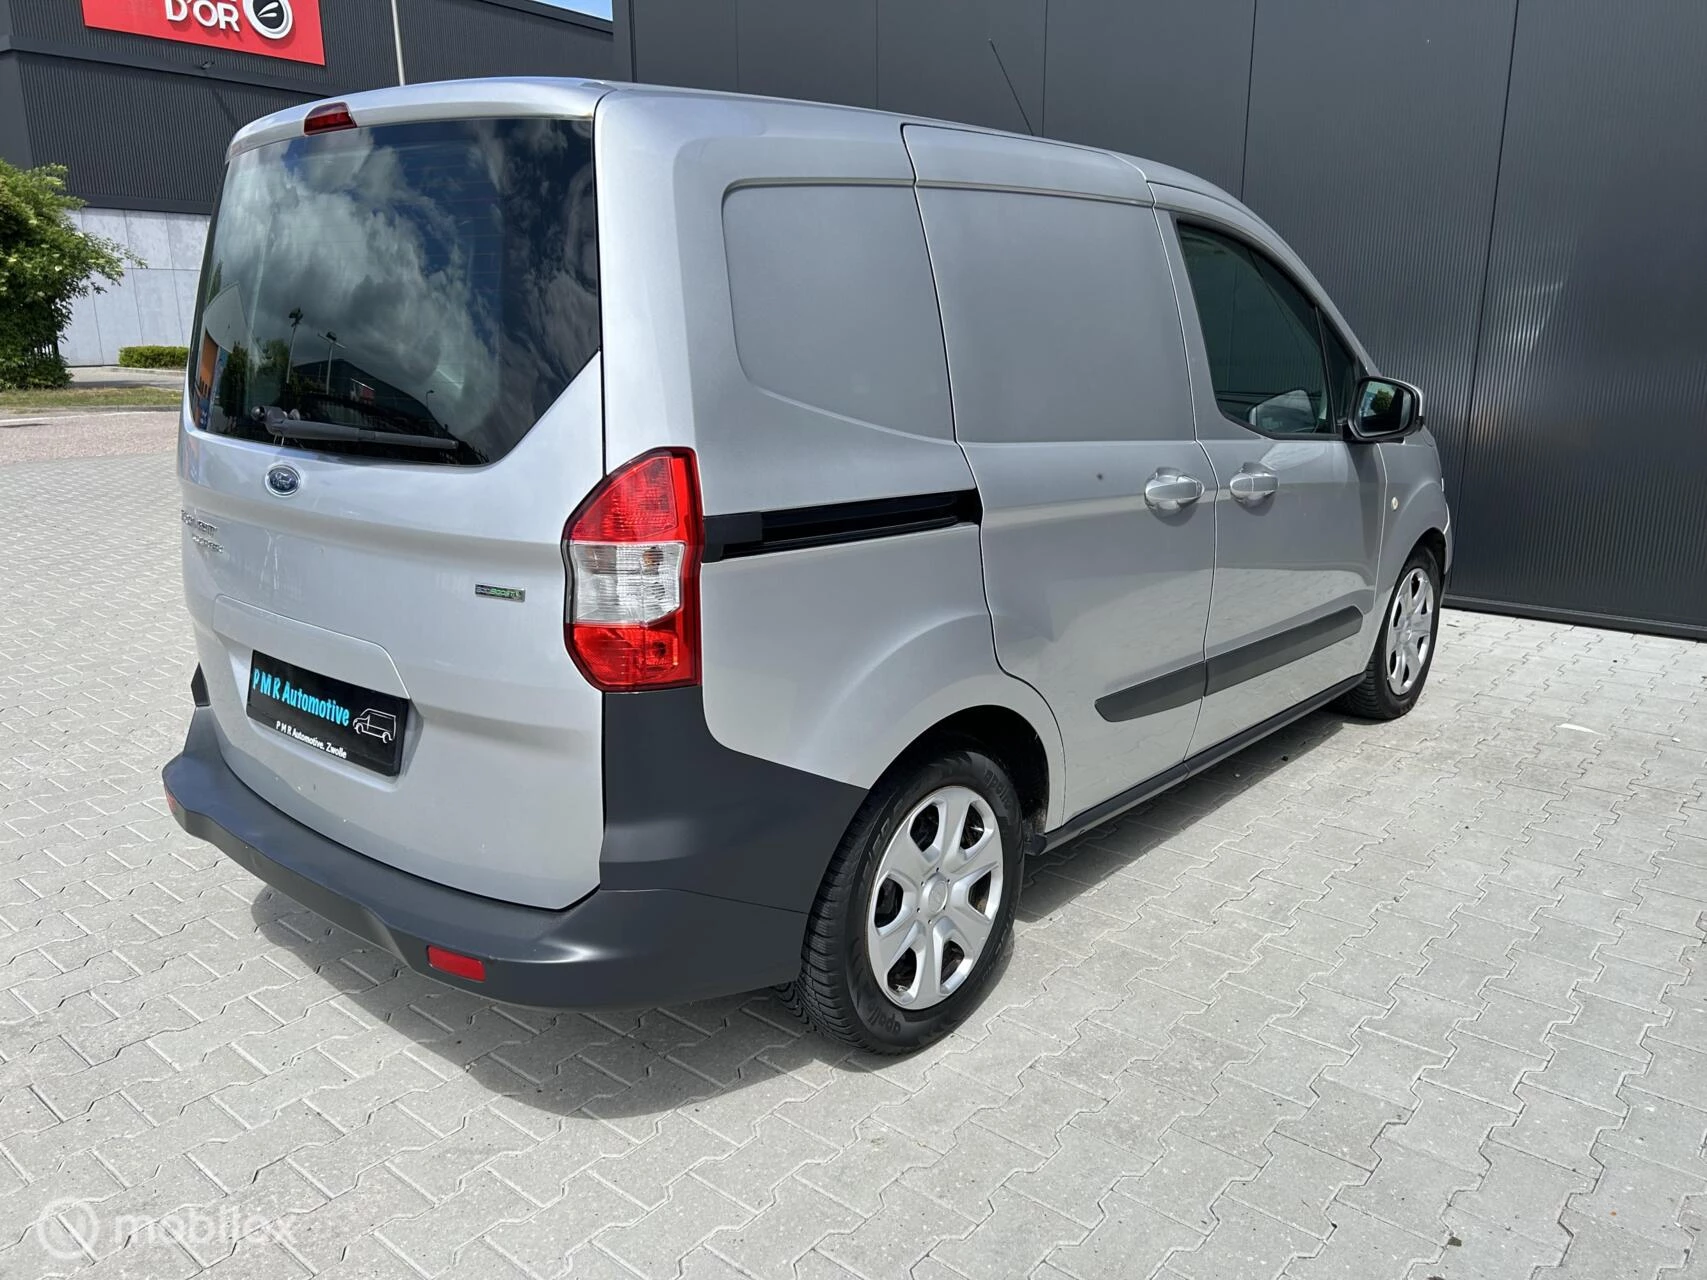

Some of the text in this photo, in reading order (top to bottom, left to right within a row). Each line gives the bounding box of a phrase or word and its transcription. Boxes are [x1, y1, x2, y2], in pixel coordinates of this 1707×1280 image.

[253, 668, 260, 689] P
[260, 673, 271, 696] M
[282, 681, 349, 727] Automotive
[326, 742, 347, 759] Zwolle
